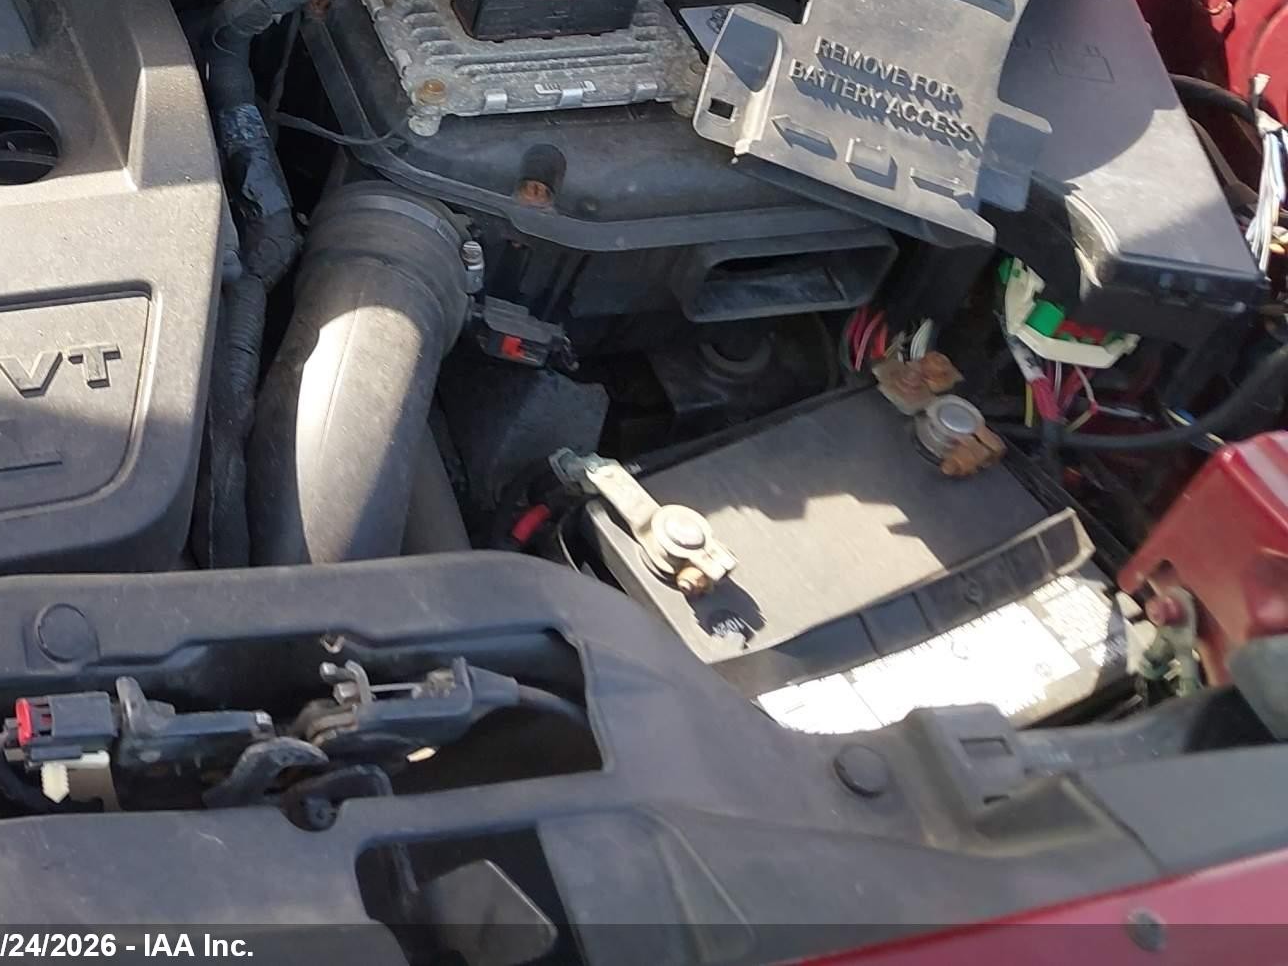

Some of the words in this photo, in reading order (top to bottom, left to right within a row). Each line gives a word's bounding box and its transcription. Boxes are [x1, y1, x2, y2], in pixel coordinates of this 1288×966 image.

[788, 57, 884, 109] BATTERY
[885, 96, 976, 143] ACCESS
[814, 35, 910, 87] REMOVE
[910, 72, 957, 105] FOR
